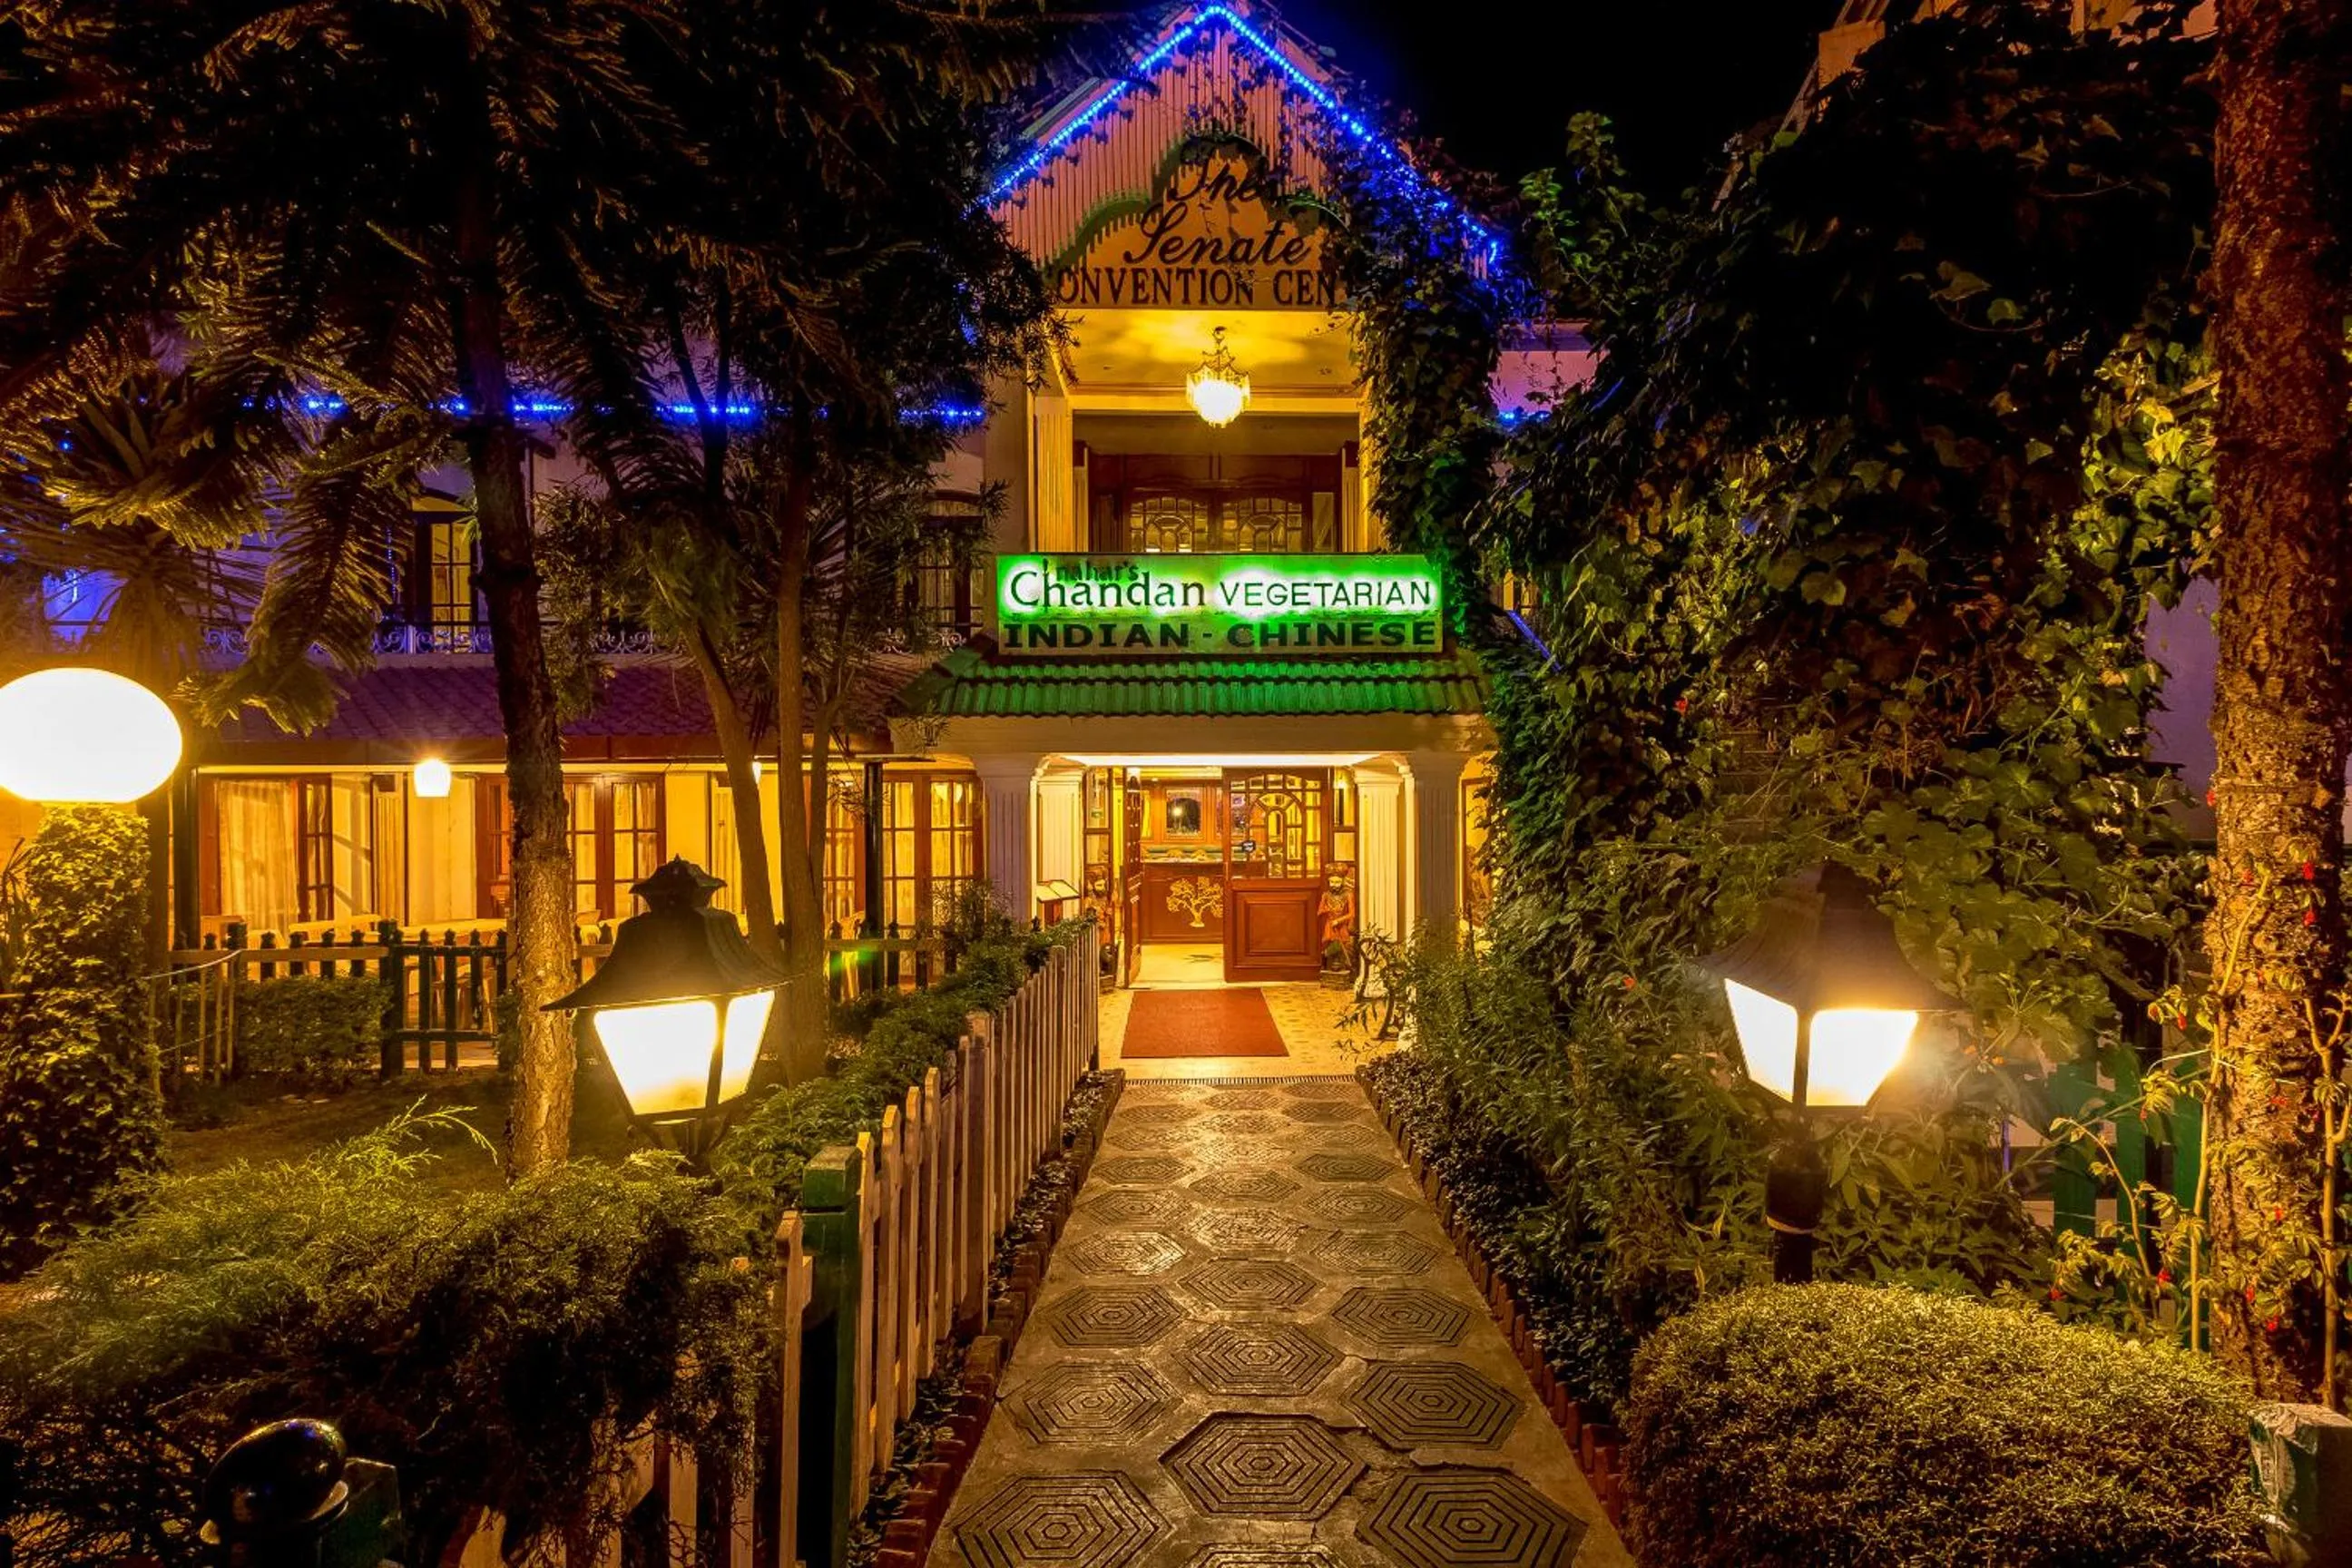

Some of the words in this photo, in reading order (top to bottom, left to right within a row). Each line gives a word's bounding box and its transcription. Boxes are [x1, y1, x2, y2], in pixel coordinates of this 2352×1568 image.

[1167, 147, 1261, 202] The
[1124, 202, 1311, 266] Senate
[1057, 266, 1254, 306] ONVENTION
[1010, 571, 1205, 608] Chandan
[1220, 581, 1431, 607] VEGETARIAN
[1004, 622, 1191, 649] INDIAN
[1227, 622, 1436, 648] CHINESE
